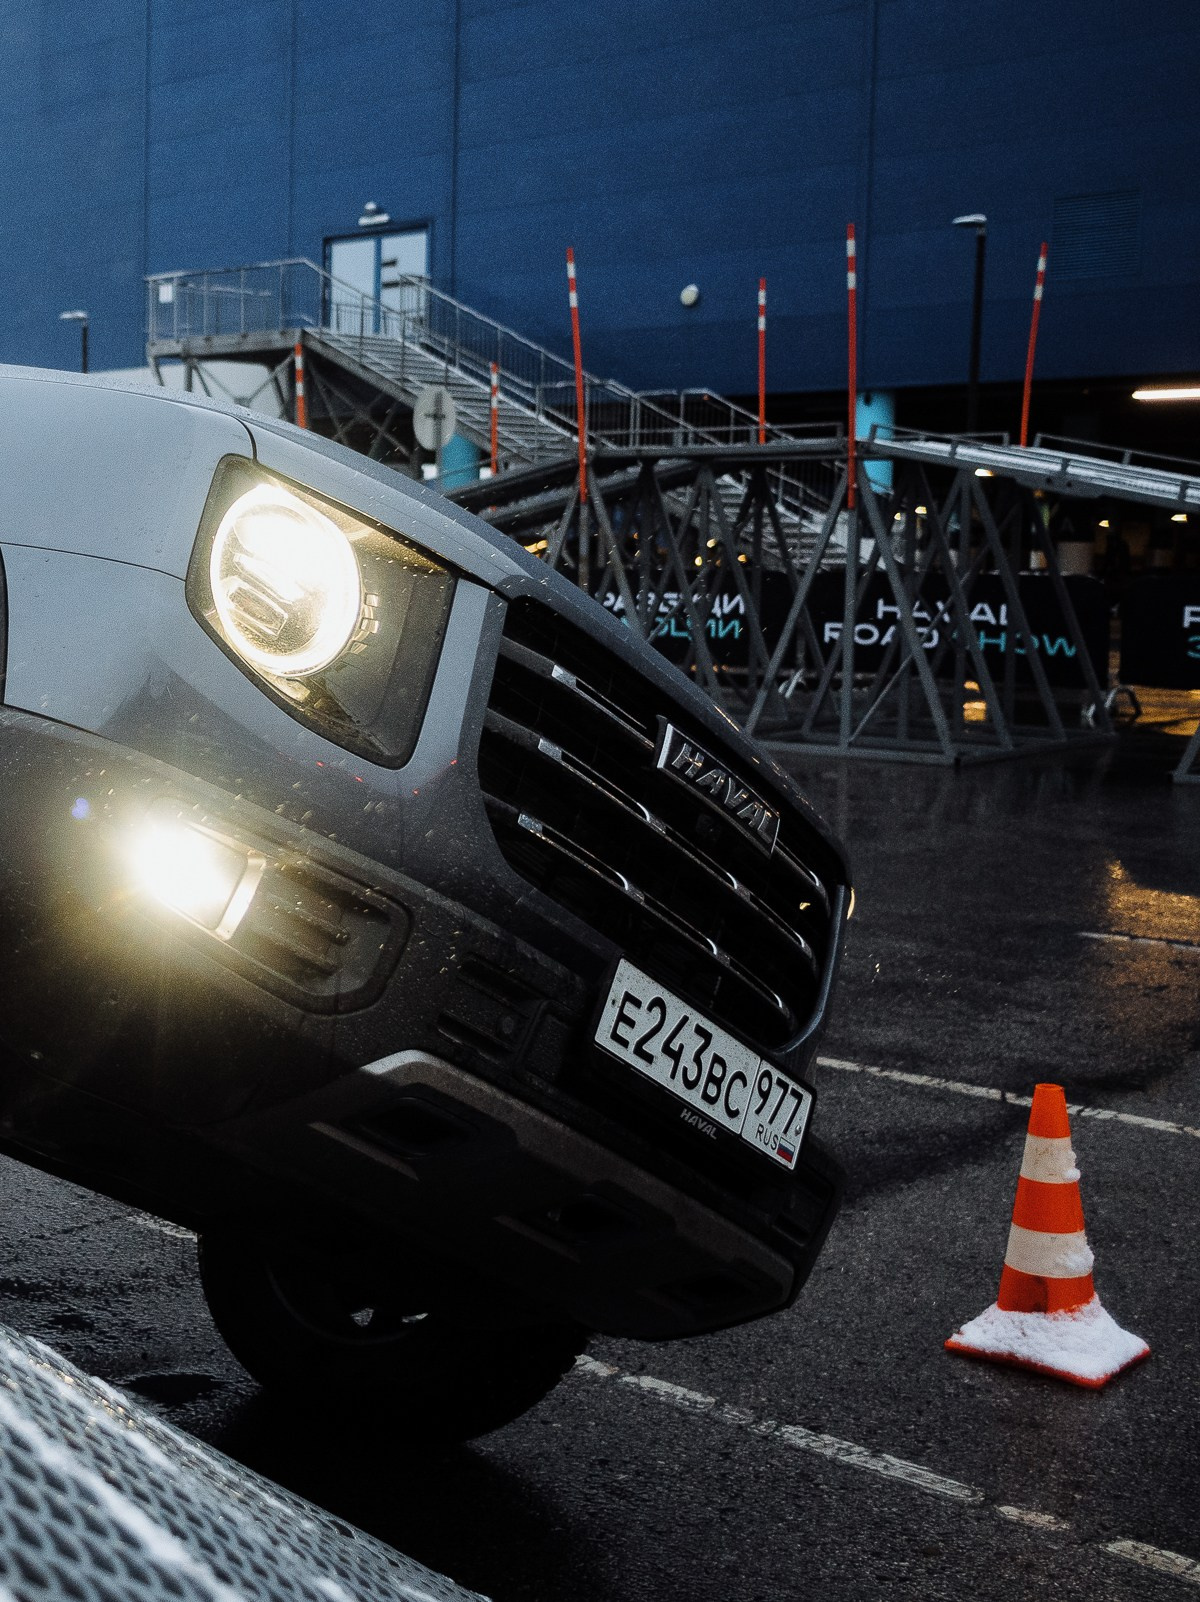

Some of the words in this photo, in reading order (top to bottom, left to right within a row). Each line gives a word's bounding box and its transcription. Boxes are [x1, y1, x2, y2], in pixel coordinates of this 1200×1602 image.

[671, 742, 774, 844] HAVAL
[679, 1108, 718, 1140] HAVAL
[754, 1069, 804, 1135] 977
[755, 1123, 779, 1151] RUS
